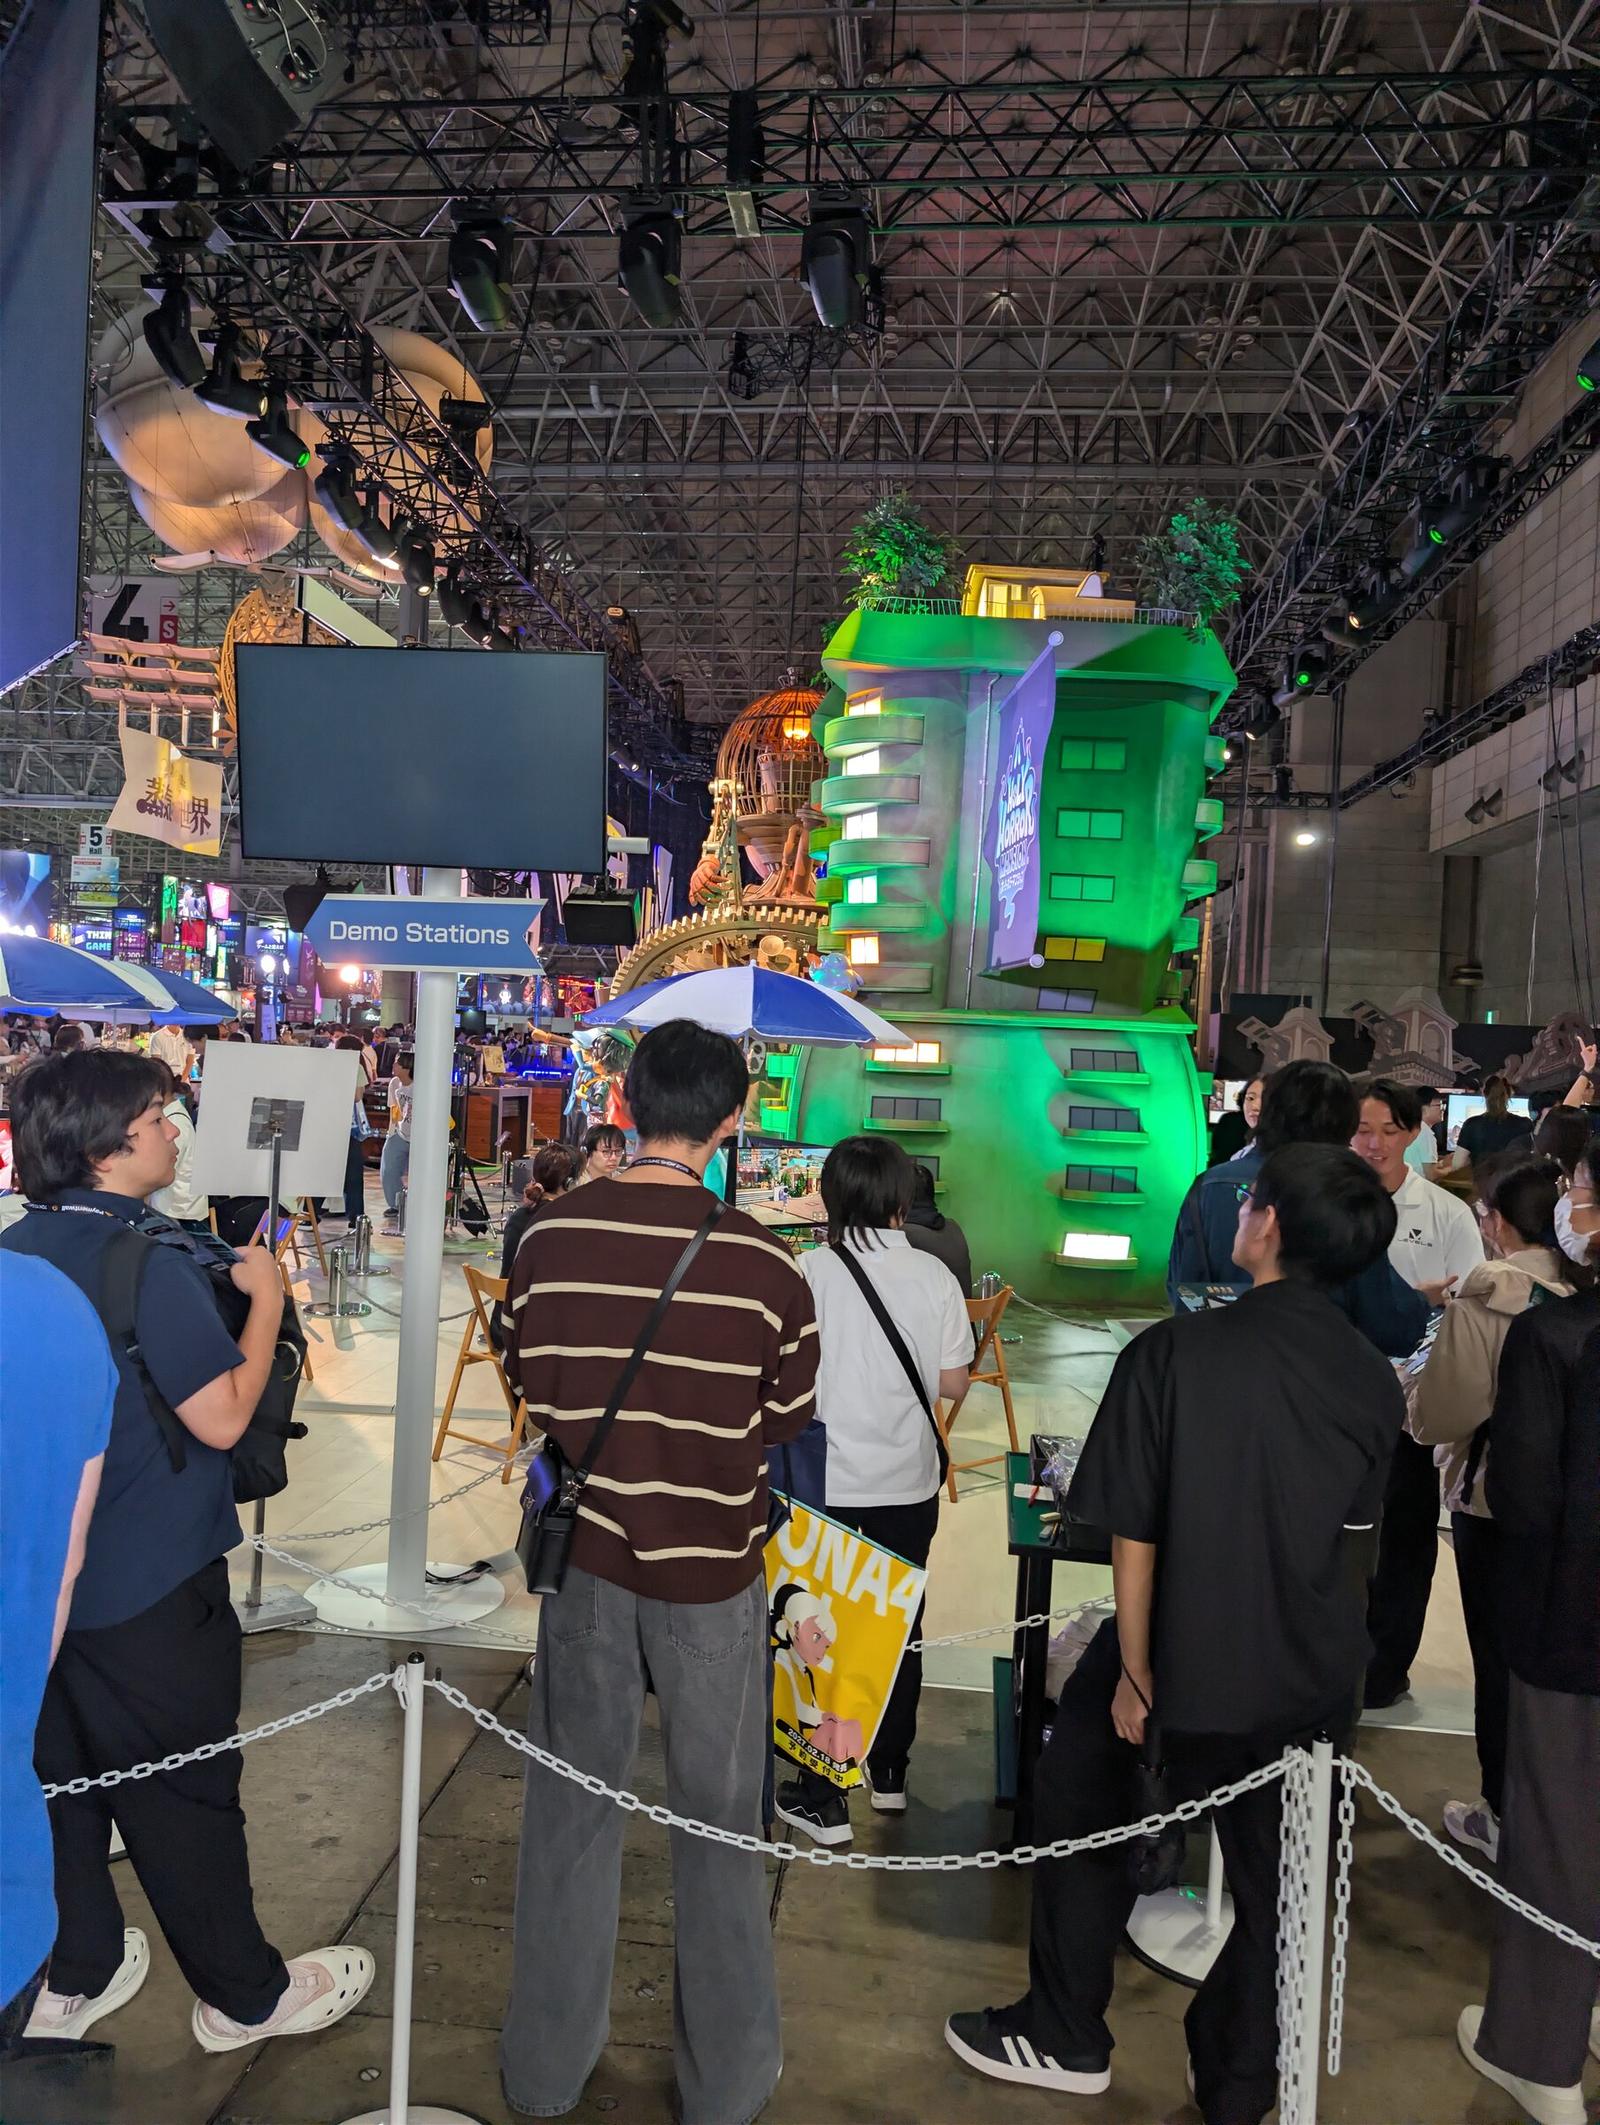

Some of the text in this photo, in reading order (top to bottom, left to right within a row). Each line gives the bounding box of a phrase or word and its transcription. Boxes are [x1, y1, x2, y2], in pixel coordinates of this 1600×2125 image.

[103, 584, 149, 643] 4
[163, 620, 174, 639] S
[90, 826, 103, 846] 5
[330, 921, 510, 945] Demo Stations
[62, 1205, 104, 1215] Paymentwall
[787, 1741, 844, 1783] 予約受付中
